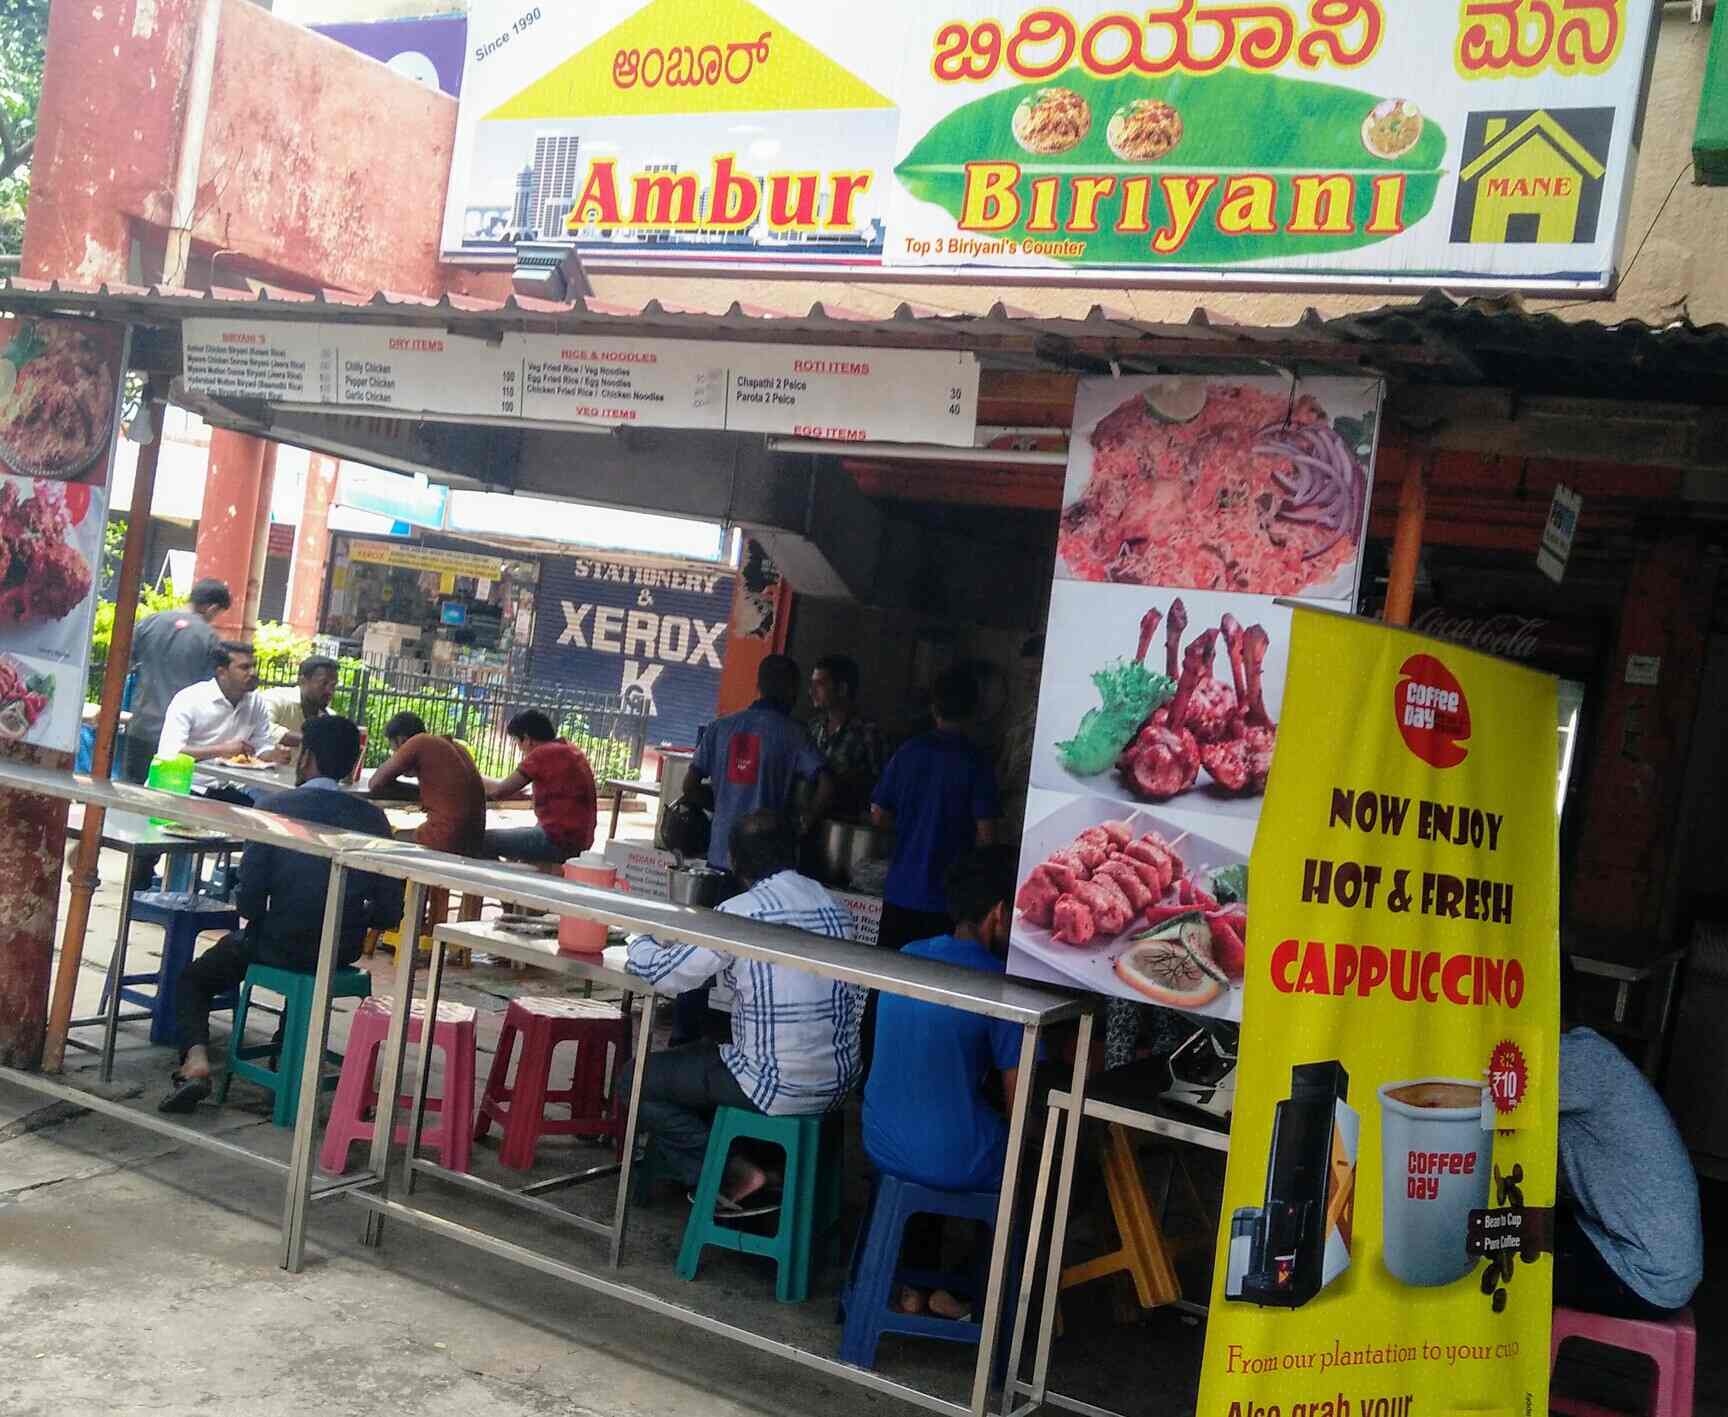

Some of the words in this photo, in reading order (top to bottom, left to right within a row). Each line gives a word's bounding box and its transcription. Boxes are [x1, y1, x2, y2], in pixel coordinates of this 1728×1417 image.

[475, 32, 510, 61] Since
[512, 7, 541, 35] 1990
[934, 0, 1382, 80] ಬಿರಿಯಾನಿ
[1460, 0, 1619, 71] ಮನ
[612, 32, 772, 89] ಆಂಬೂರ್
[566, 152, 873, 234] Ambur
[1486, 175, 1573, 199] MANE
[958, 160, 1405, 253] Biriyani
[905, 238, 930, 256] Top
[935, 239, 944, 253] 3
[948, 238, 1017, 257] Biriyani's
[1023, 238, 1086, 256] Counter
[389, 338, 409, 350] DRY
[412, 339, 444, 352] ITEMS
[365, 361, 391, 374] Chicken
[601, 351, 657, 363] NOODLES
[528, 363, 542, 375] Veg
[585, 365, 599, 377] Veg
[600, 367, 630, 377] Noodles
[793, 360, 827, 373] ROTI
[828, 361, 870, 376] ITEMS
[369, 376, 395, 388] Chicken
[527, 374, 542, 386] Egg
[585, 377, 600, 389] Egg
[601, 378, 631, 388] Noodles
[737, 376, 774, 390] Chapathi
[775, 377, 782, 389] 2
[949, 388, 962, 400] 30
[365, 391, 391, 402] Chicken
[527, 385, 555, 395] Chicken
[601, 389, 631, 400] Chicken
[633, 391, 664, 402] Noodles
[765, 392, 771, 403] 2
[949, 403, 961, 416] 40
[576, 405, 601, 417] VEG
[602, 407, 637, 420] ITEMS
[793, 424, 823, 438] EGG
[826, 426, 867, 441] ITEMS
[574, 559, 720, 593] STATIONERY
[637, 588, 653, 607] &
[556, 600, 728, 669] XEROX
[1329, 787, 1411, 835] NOW
[1418, 800, 1503, 851] ENJOY
[1301, 858, 1382, 909] HOT
[1386, 869, 1413, 913] &
[1421, 872, 1514, 925] FRESH
[1269, 939, 1524, 1009] CAPPUCCINO
[1507, 1212, 1522, 1228] Cup
[1501, 1235, 1521, 1248] Coffee
[1226, 1343, 1278, 1374] From
[1282, 1353, 1316, 1370] our
[1320, 1340, 1417, 1374] plantation
[1423, 1341, 1442, 1360] to
[1446, 1344, 1492, 1366] your
[1226, 1400, 1281, 1417] Also
[1291, 1393, 1350, 1417] grab
[1360, 1393, 1413, 1417] your
